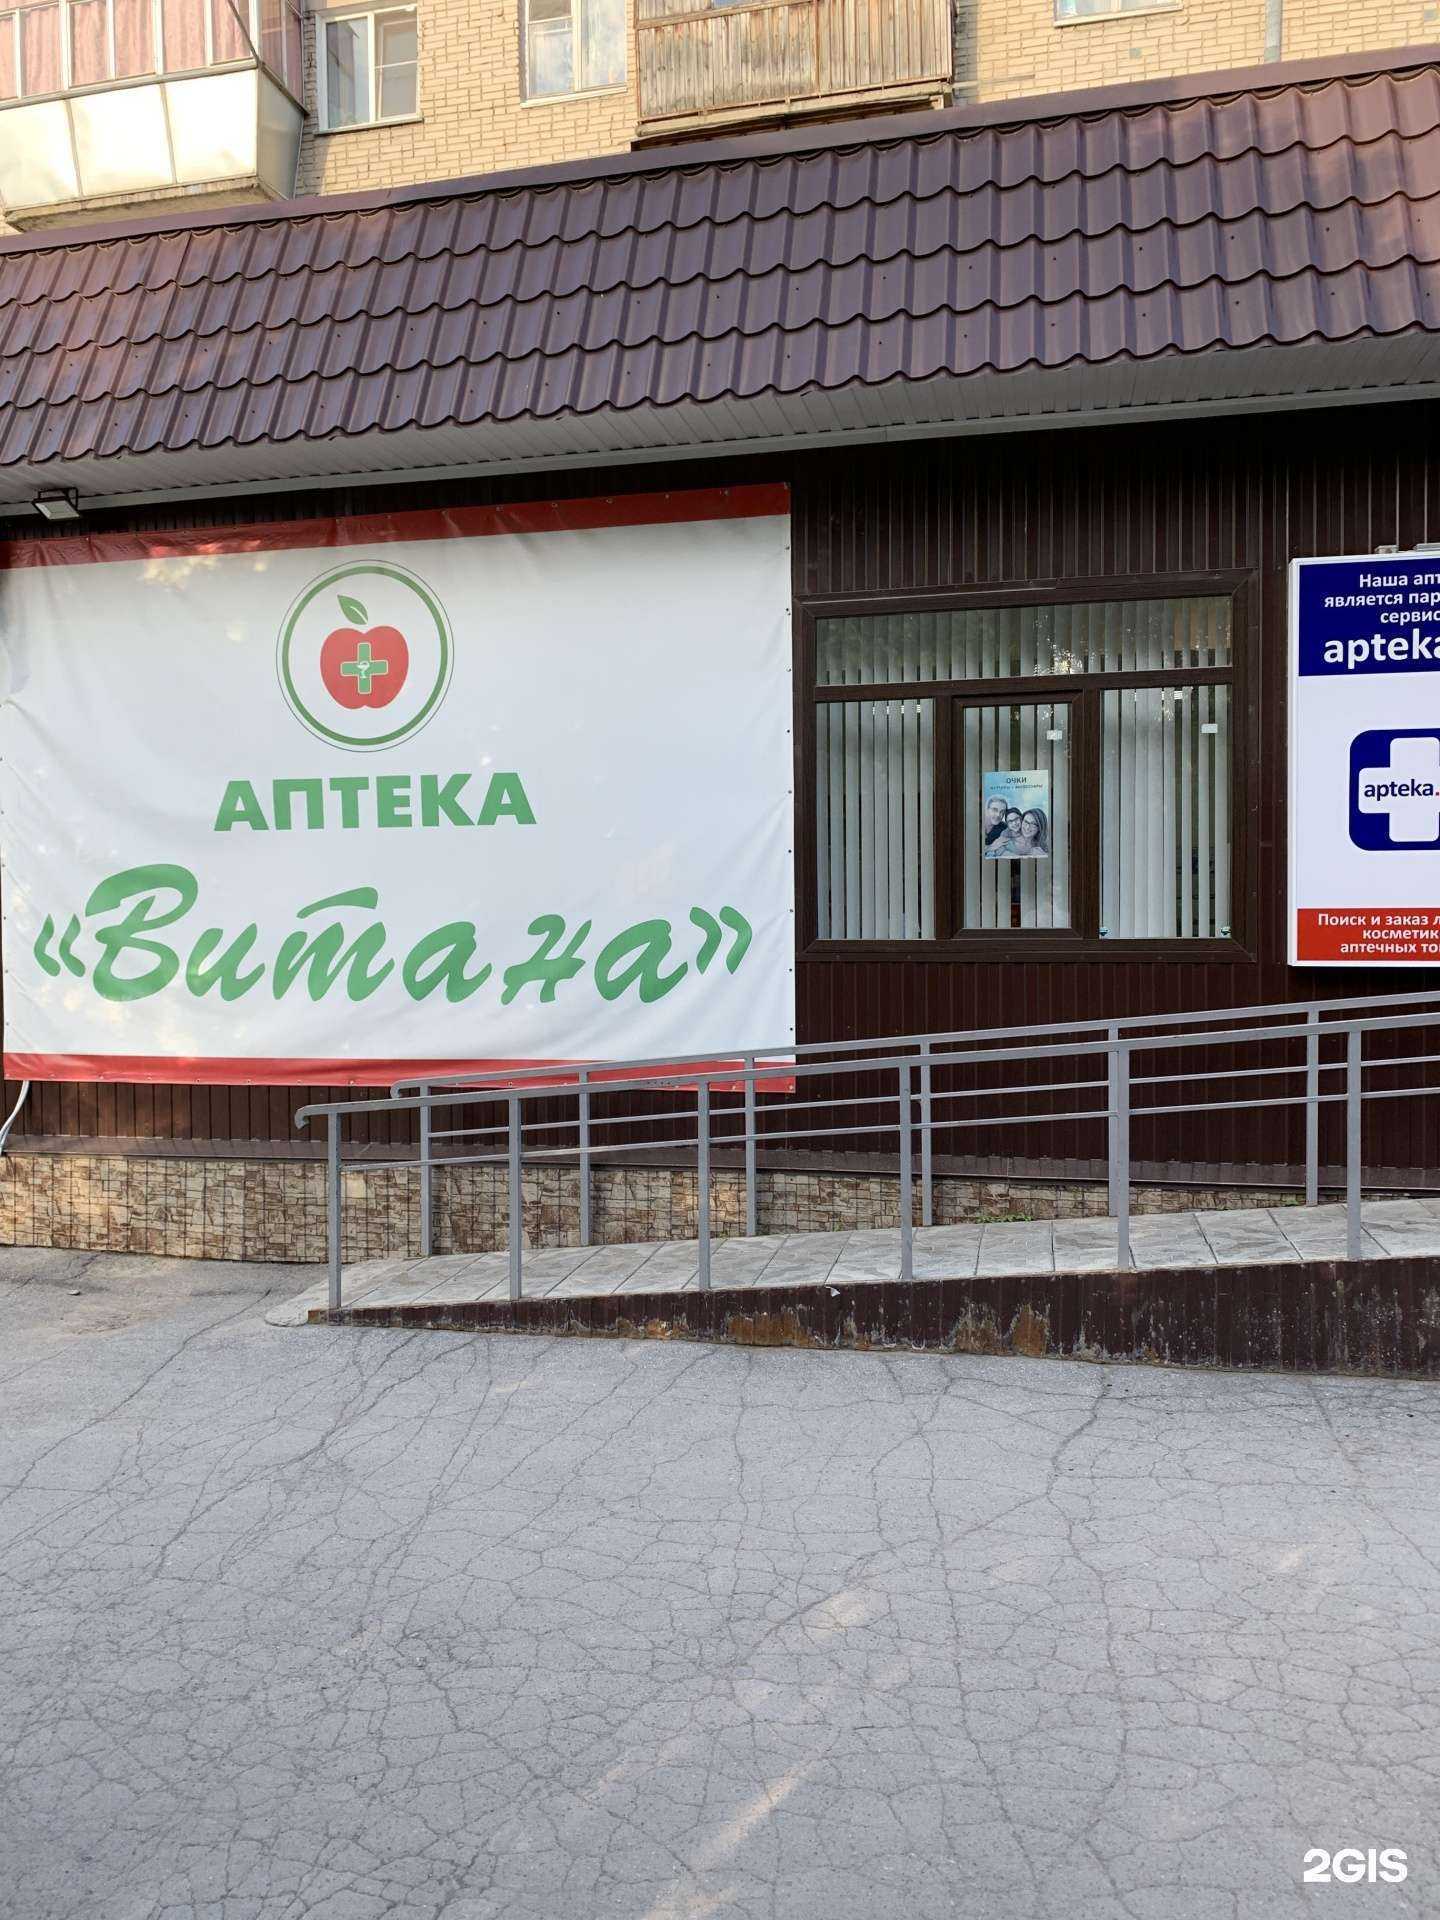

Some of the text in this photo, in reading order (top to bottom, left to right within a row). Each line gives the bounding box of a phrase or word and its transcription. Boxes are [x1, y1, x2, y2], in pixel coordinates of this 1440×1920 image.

[1359, 573, 1408, 588] Наша
[1324, 591, 1440, 608] является пар
[1380, 610, 1440, 626] сервис
[214, 772, 537, 832] АПТЕКА
[1318, 913, 1366, 926] Поиск
[1371, 916, 1381, 926] и
[1385, 915, 1428, 926] заказ
[1362, 929, 1439, 940] косметик
[1340, 943, 1440, 953] аптечных то
